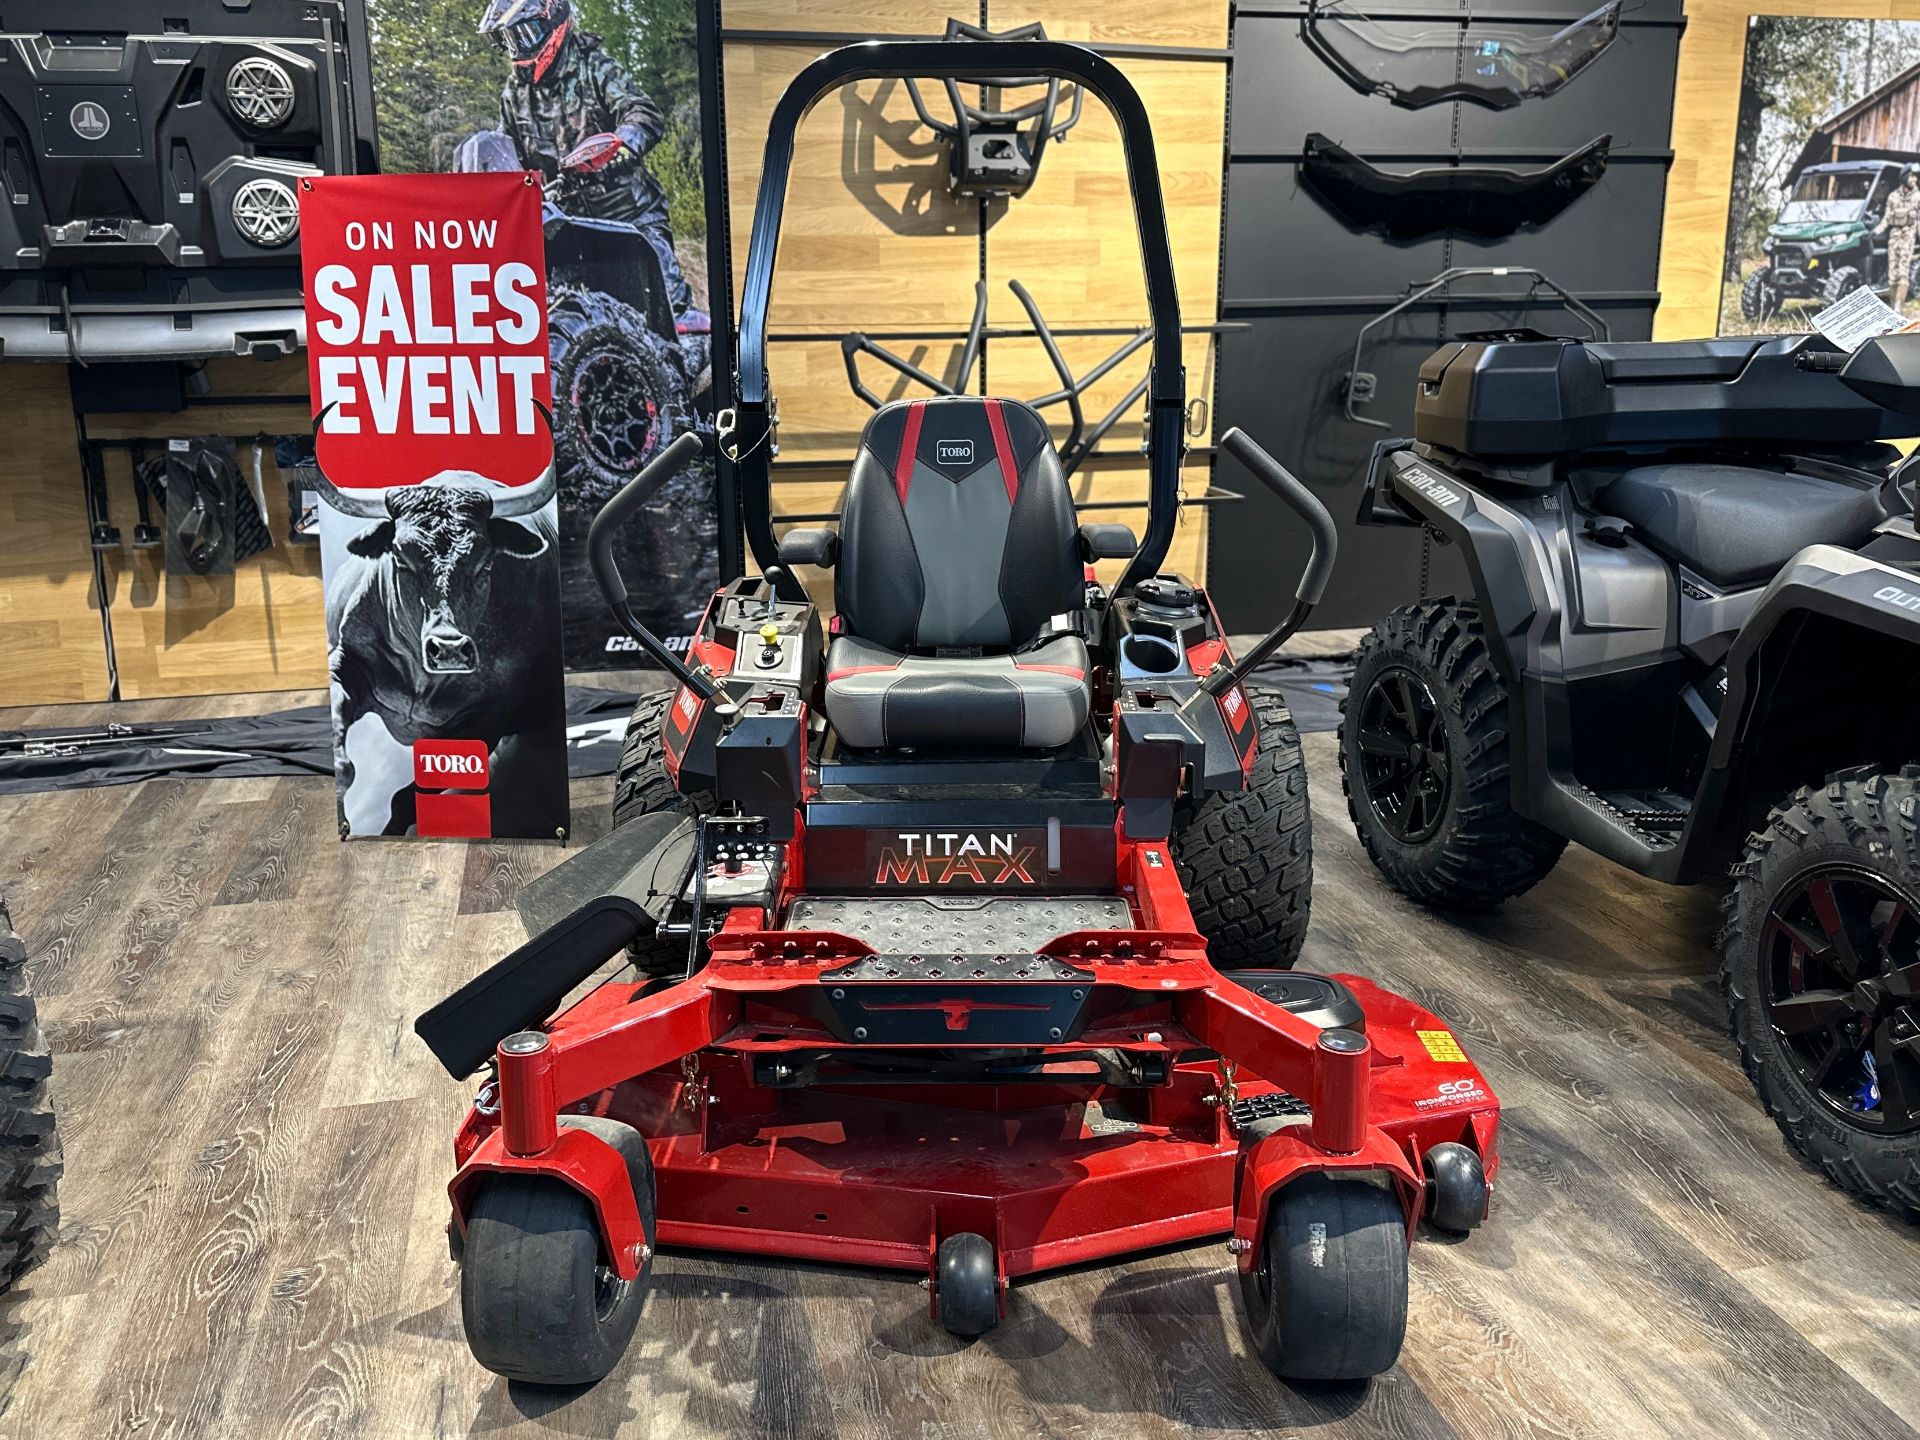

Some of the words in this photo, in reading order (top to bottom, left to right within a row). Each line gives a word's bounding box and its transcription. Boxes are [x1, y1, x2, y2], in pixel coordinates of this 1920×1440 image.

[345, 221, 393, 250] ON
[415, 220, 497, 249] NOW
[314, 262, 540, 346] SALES
[318, 356, 545, 434] EVENT
[940, 447, 970, 457] TORO
[1402, 467, 1461, 507] can-am
[679, 687, 697, 721] TORO
[1224, 686, 1242, 719] TORO
[899, 833, 1015, 856] TITAN
[876, 847, 1037, 884] MAX
